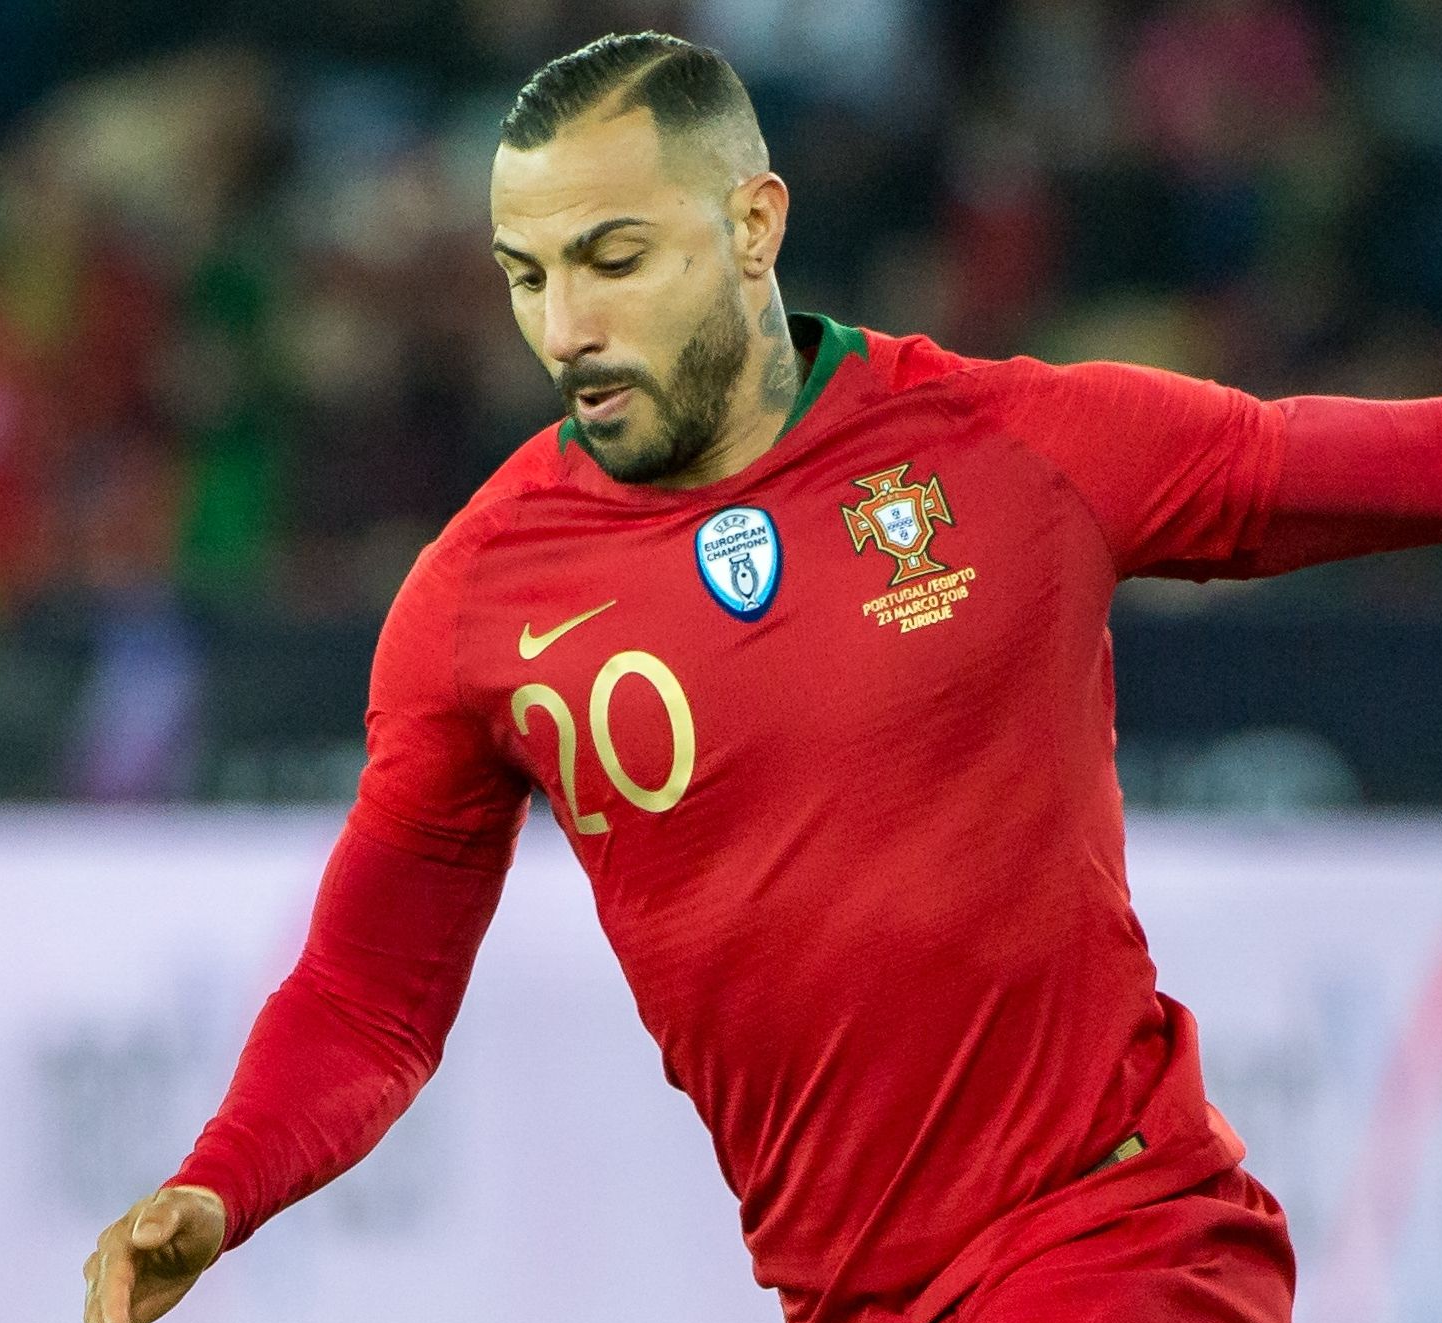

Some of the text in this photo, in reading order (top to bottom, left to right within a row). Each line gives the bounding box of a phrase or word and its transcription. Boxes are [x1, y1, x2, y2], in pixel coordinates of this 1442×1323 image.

[714, 516, 747, 533] UEFA
[704, 526, 766, 552] EUROPEAN
[706, 536, 769, 562] CHAMPIONS
[862, 567, 976, 617] PORTUGAL/EGIPTO
[876, 610, 894, 627] 23
[939, 585, 969, 605] 2018
[899, 605, 954, 633] ZURIQUE
[510, 650, 696, 835] 20
